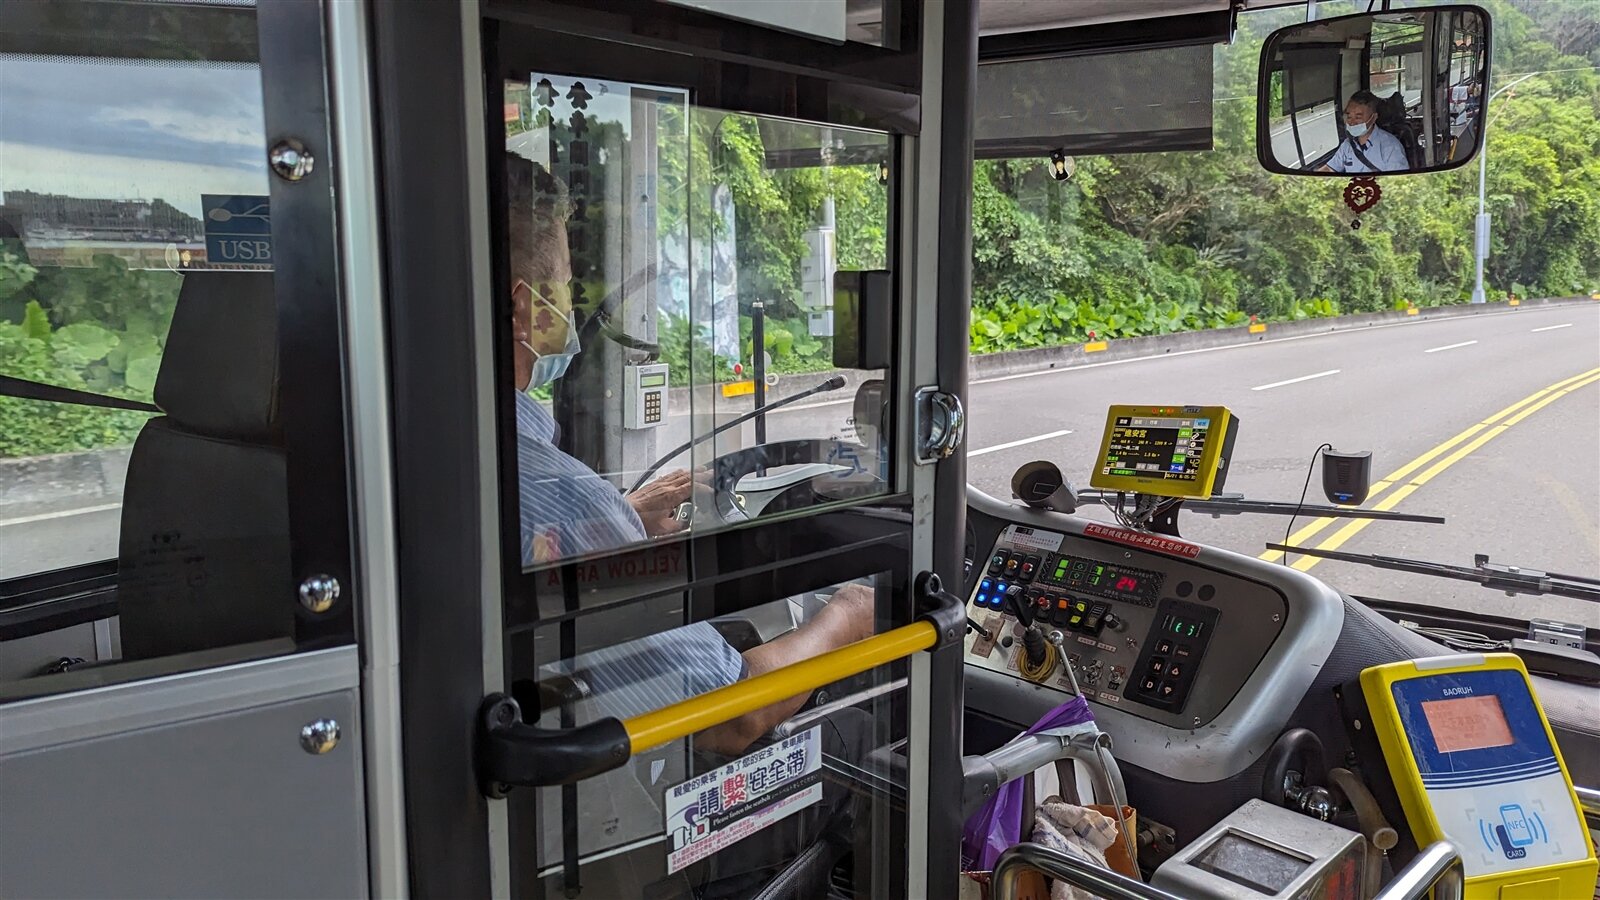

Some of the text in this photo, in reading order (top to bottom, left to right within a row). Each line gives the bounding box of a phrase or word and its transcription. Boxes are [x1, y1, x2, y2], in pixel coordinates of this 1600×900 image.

[219, 240, 272, 260] USB
[1115, 577, 1137, 591] 24
[1161, 644, 1169, 653] R
[1153, 663, 1162, 671] N
[1146, 681, 1154, 689] D
[1442, 686, 1473, 697] BAORUH
[699, 746, 804, 820] 請繫安全帶
[713, 814, 729, 827] Please
[744, 801, 753, 812] the
[1508, 819, 1525, 829] NFC
[1507, 849, 1525, 858] CARD
